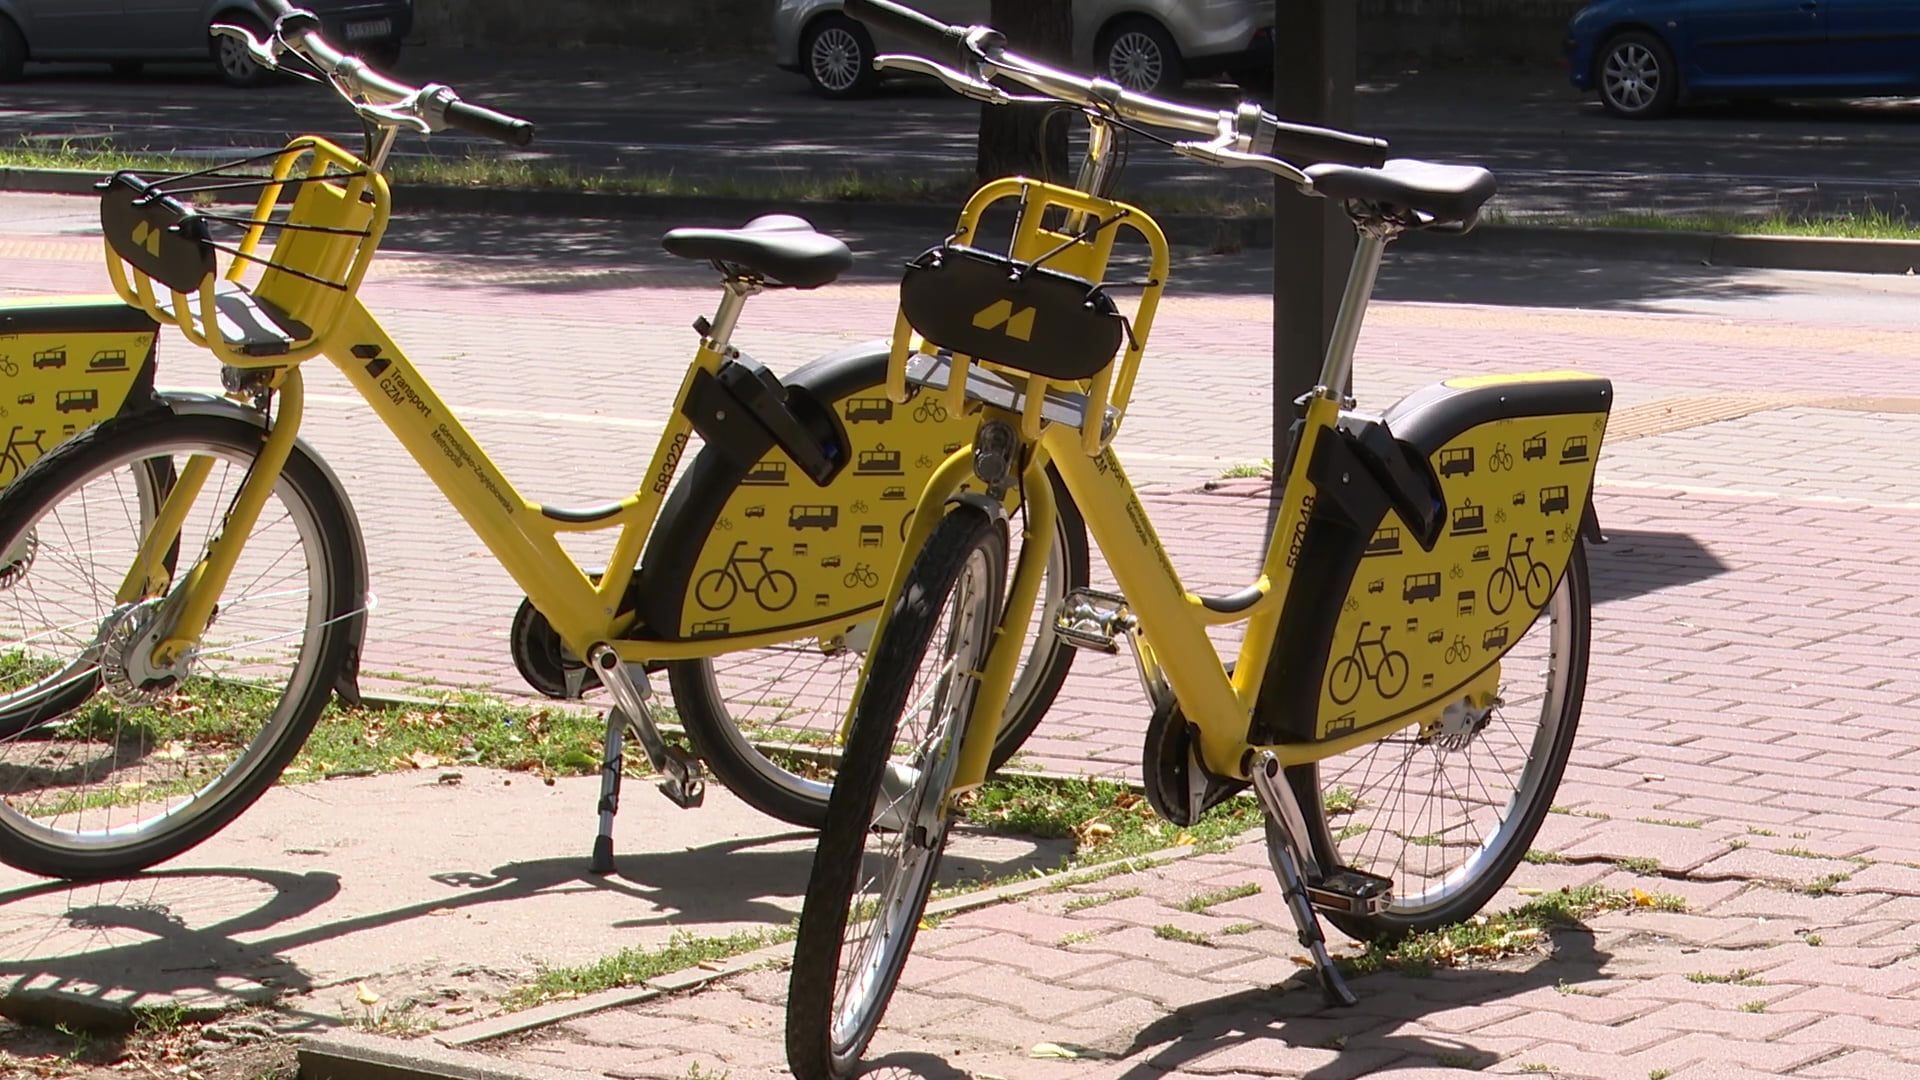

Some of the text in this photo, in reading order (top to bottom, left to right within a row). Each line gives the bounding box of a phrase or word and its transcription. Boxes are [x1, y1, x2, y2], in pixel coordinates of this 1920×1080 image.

[380, 378, 405, 406] GZM
[392, 366, 432, 418] Transport
[431, 429, 463, 468] Metropolia
[653, 433, 689, 495] 583229
[1286, 495, 1315, 568] 587048
